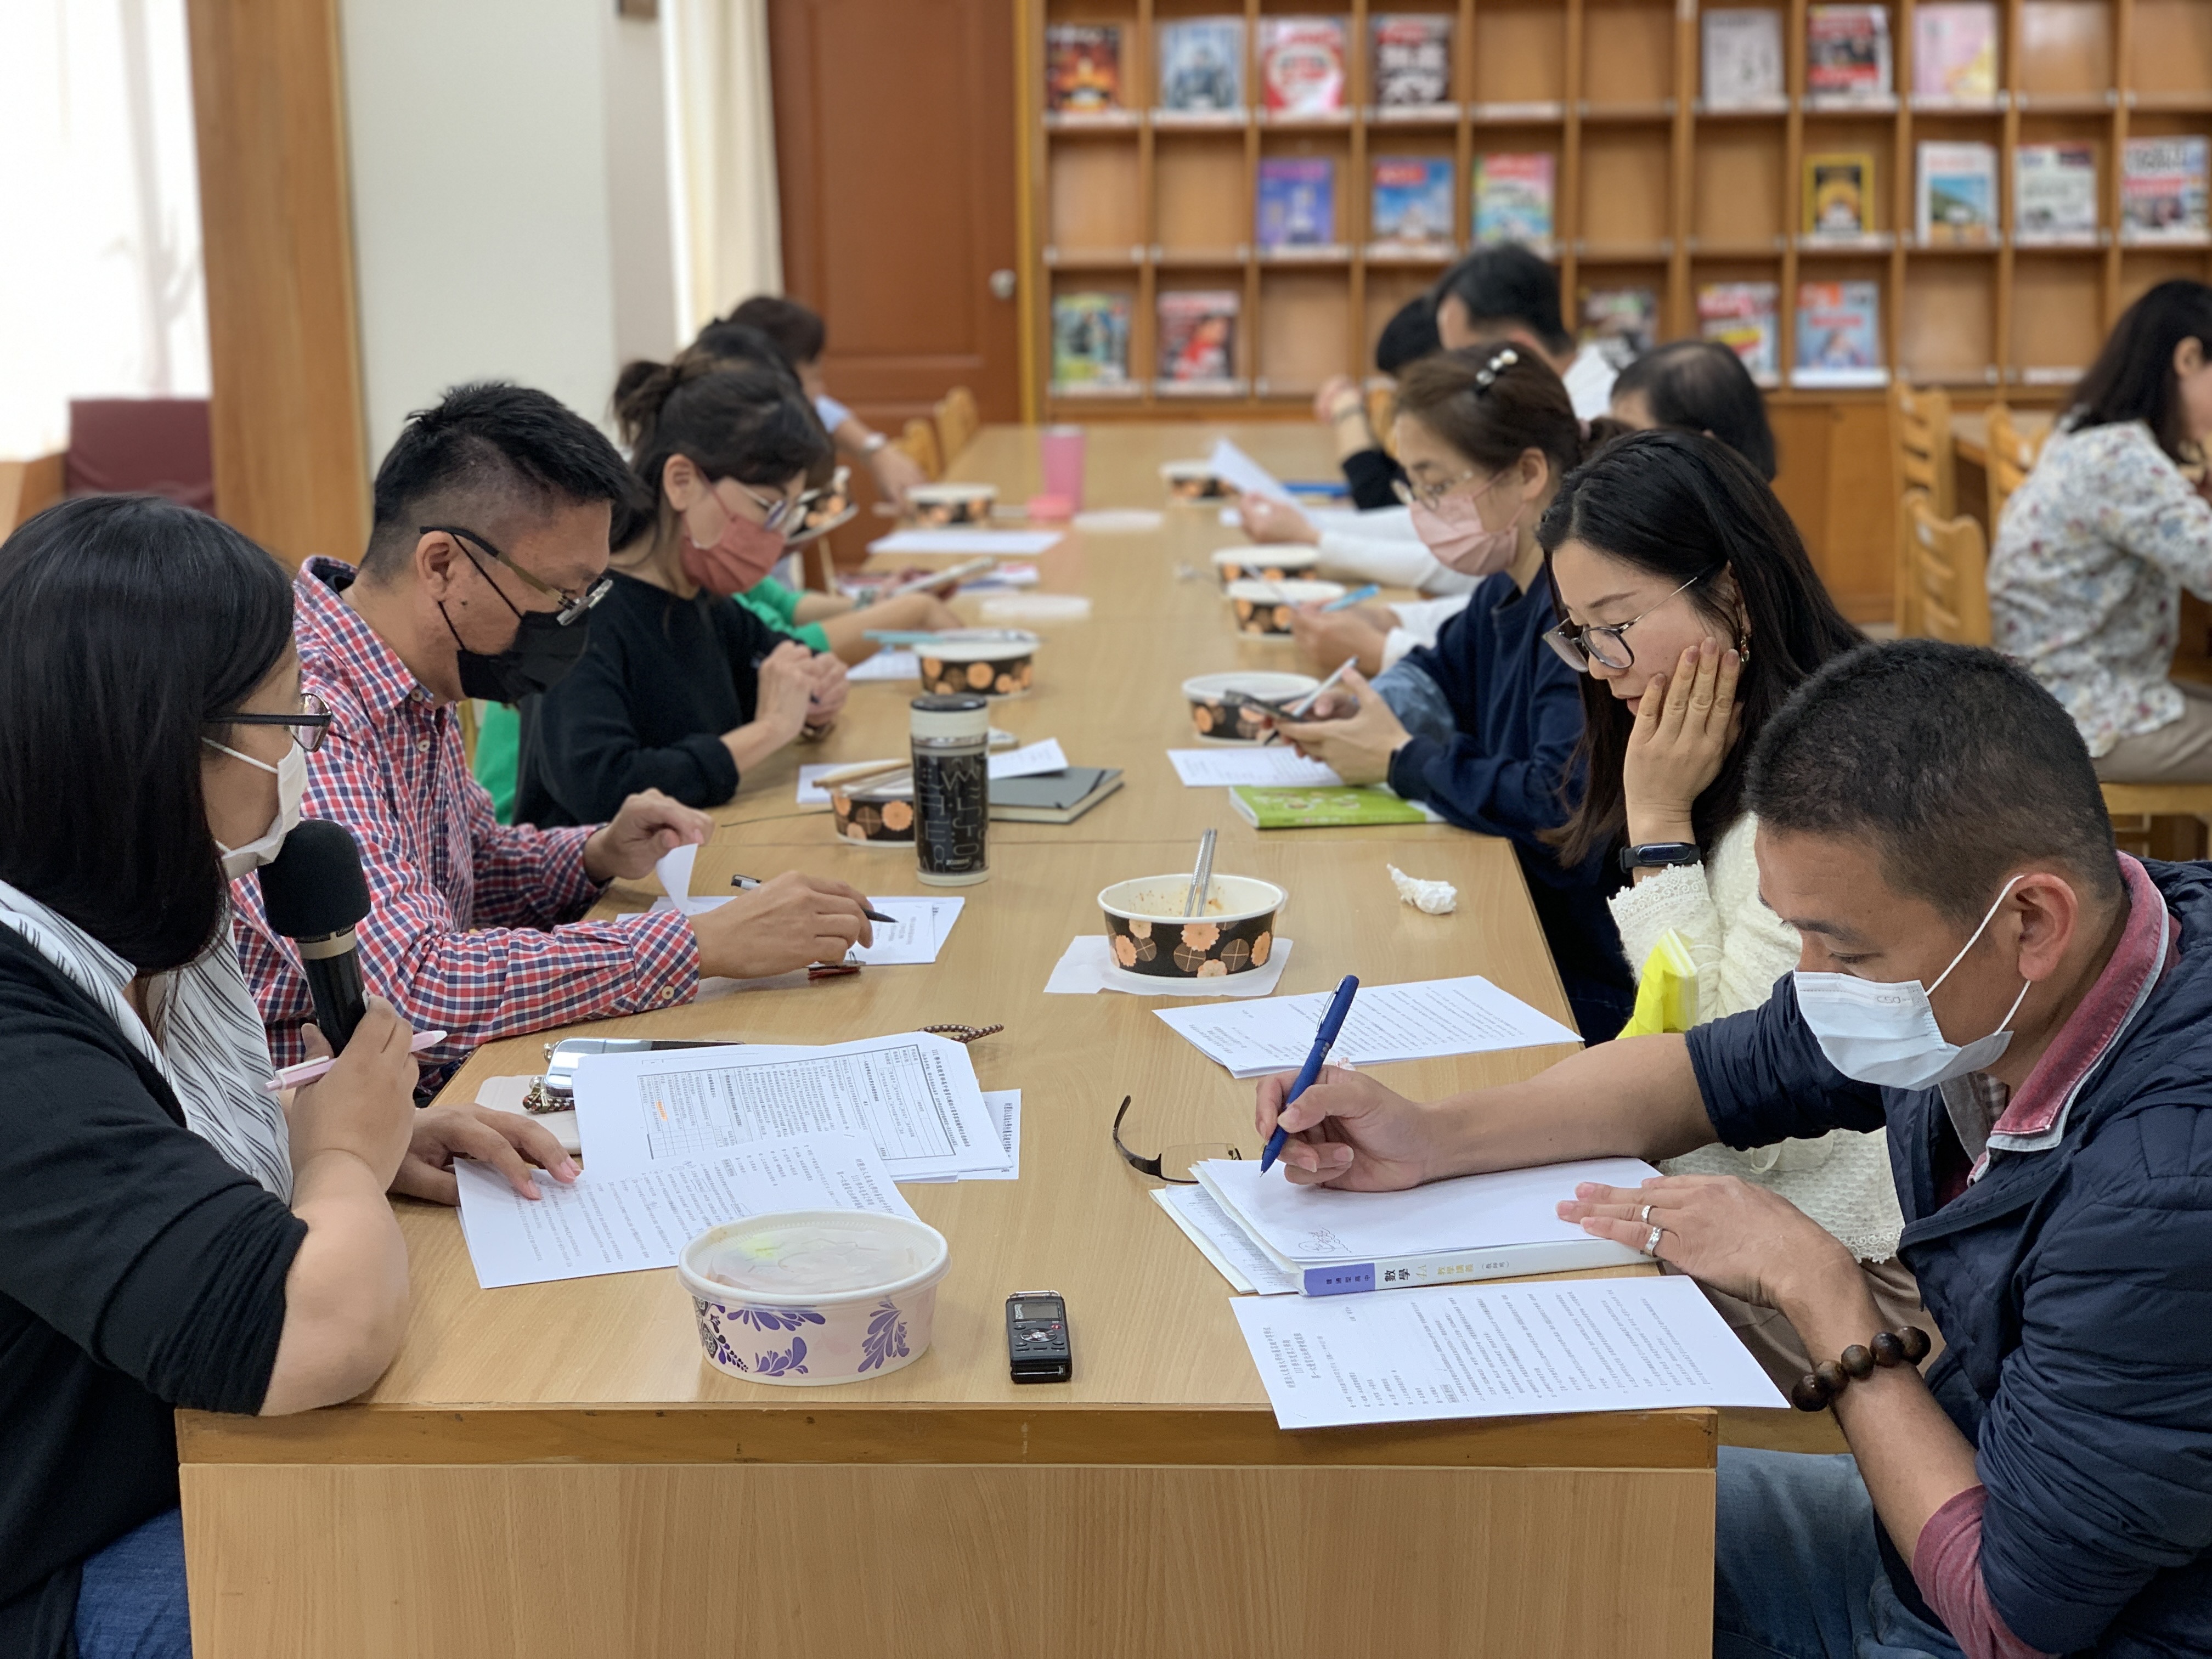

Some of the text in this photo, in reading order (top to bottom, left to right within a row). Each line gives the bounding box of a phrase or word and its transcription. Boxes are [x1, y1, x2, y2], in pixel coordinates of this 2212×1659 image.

[1384, 1268, 1410, 1282] 數學
[1415, 1265, 1427, 1280] 4A
[1437, 1263, 1474, 1276] 教學講義
